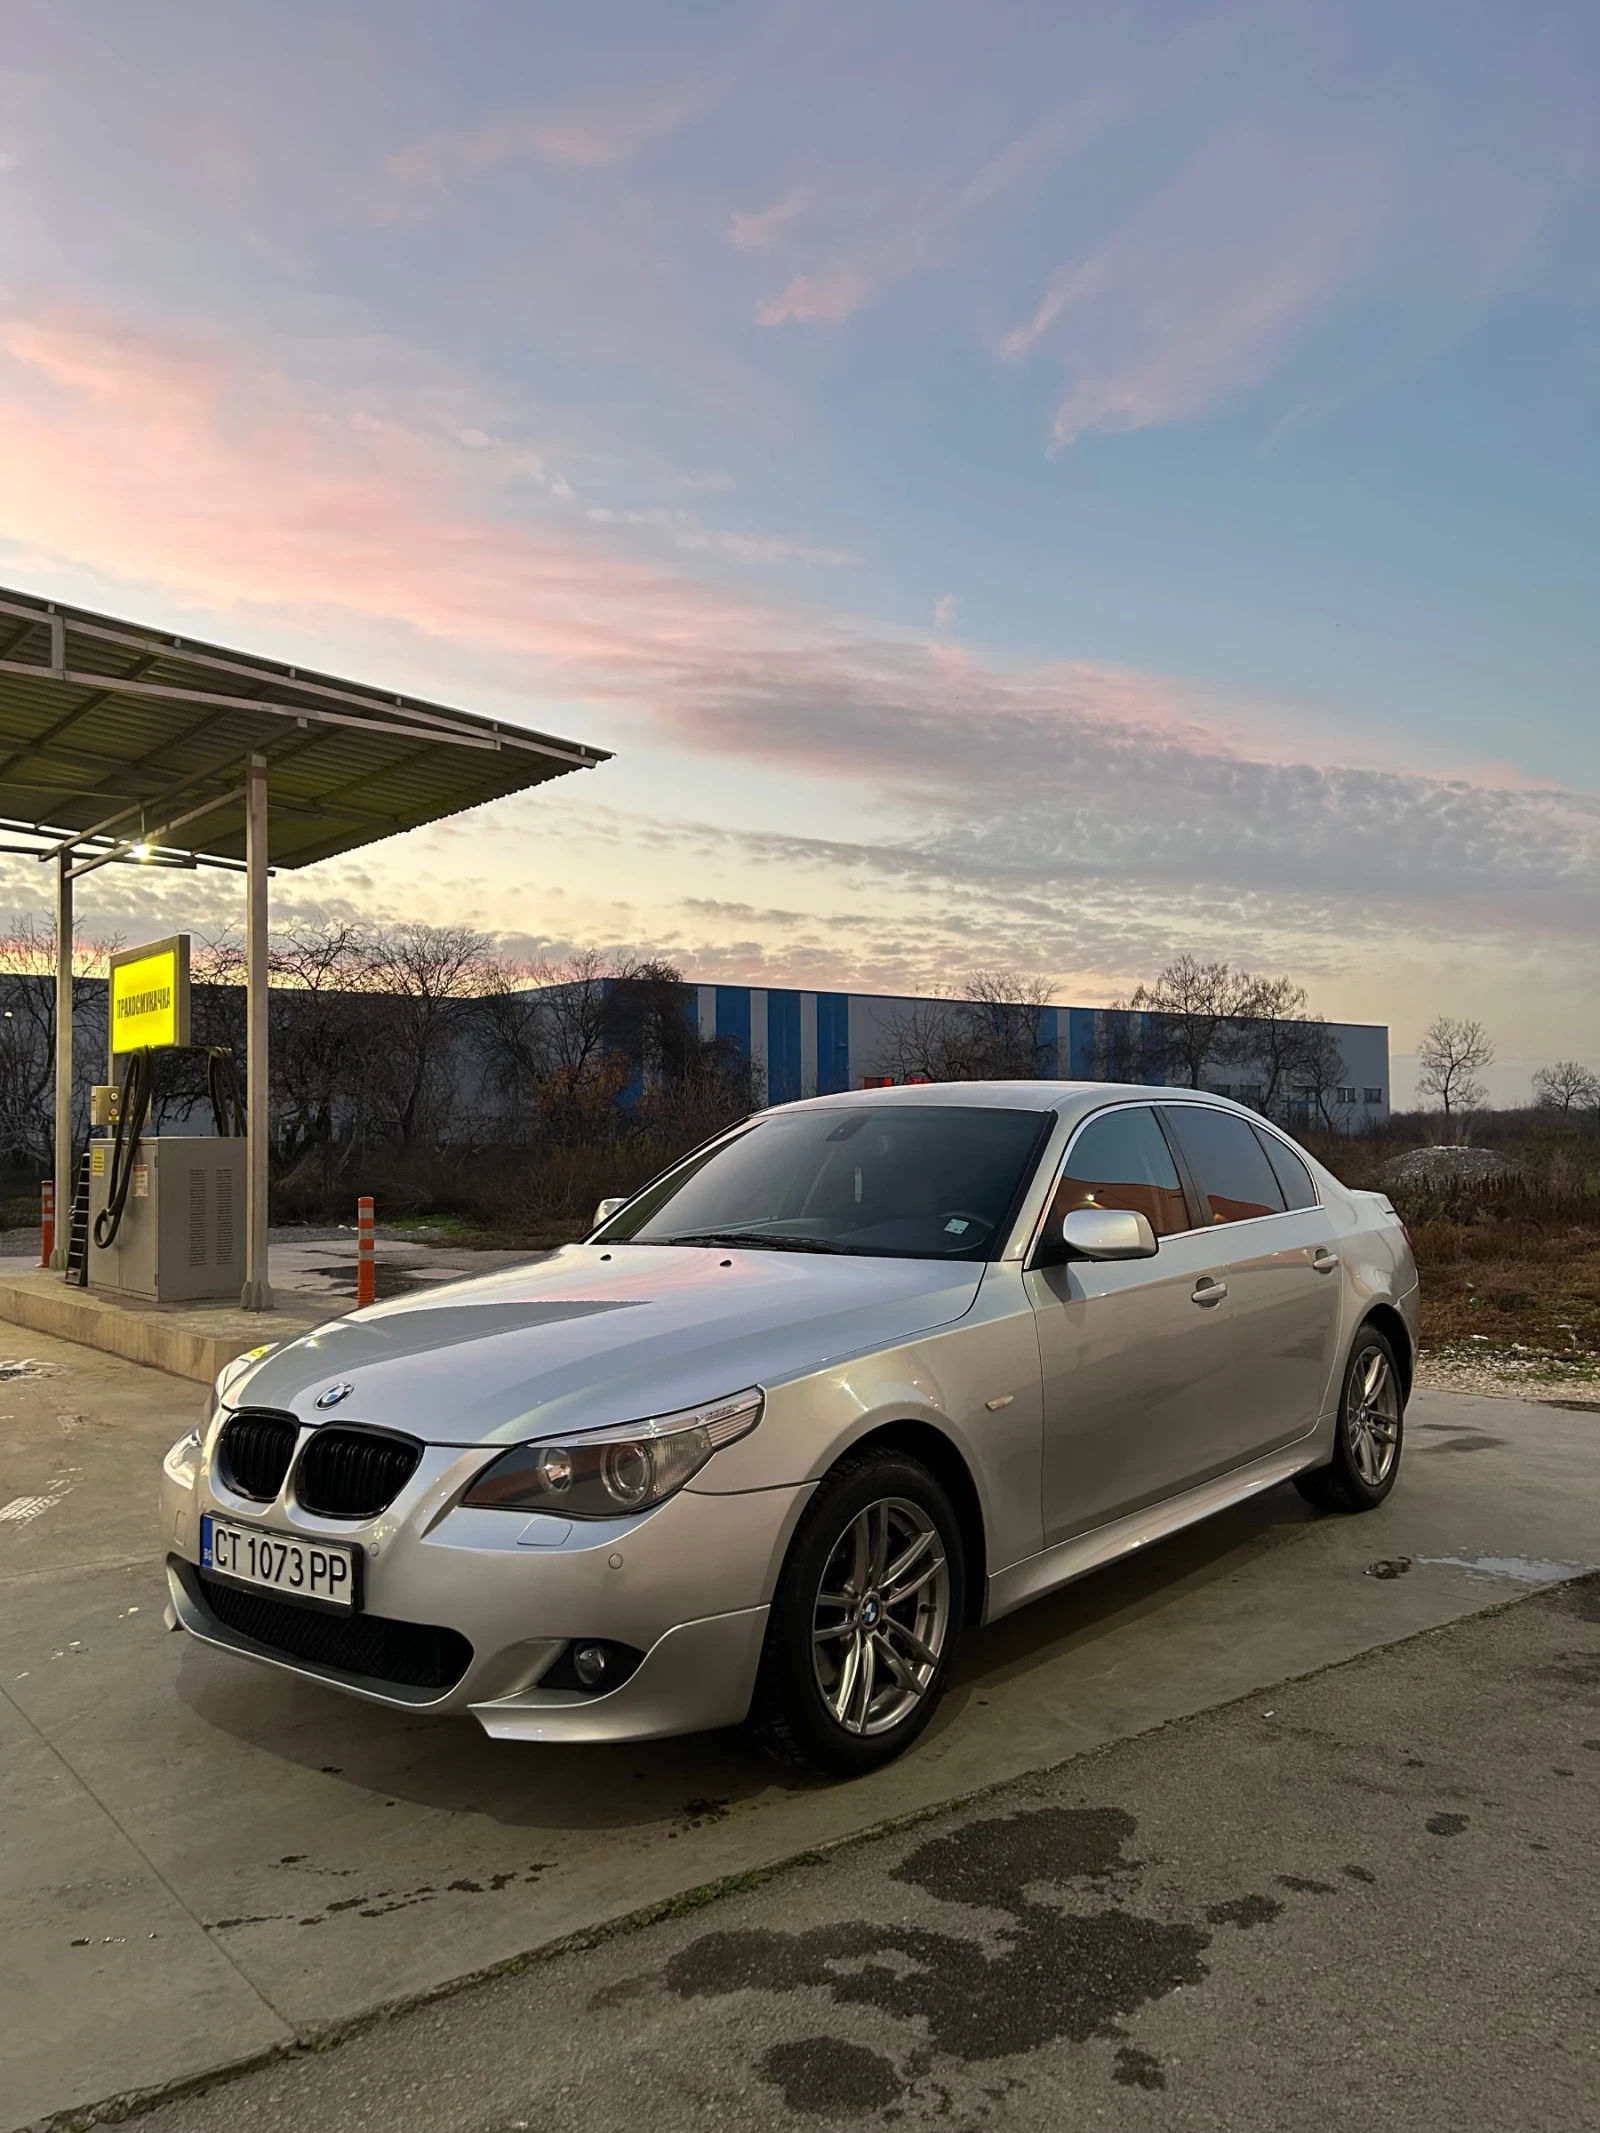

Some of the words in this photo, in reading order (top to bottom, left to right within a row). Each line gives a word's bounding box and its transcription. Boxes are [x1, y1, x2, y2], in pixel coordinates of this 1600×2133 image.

[117, 986, 171, 1019] ПРАХОСМУКАЧКА
[215, 1527, 241, 1570] CT
[248, 1536, 304, 1587] 1073
[310, 1549, 347, 1594] PP
